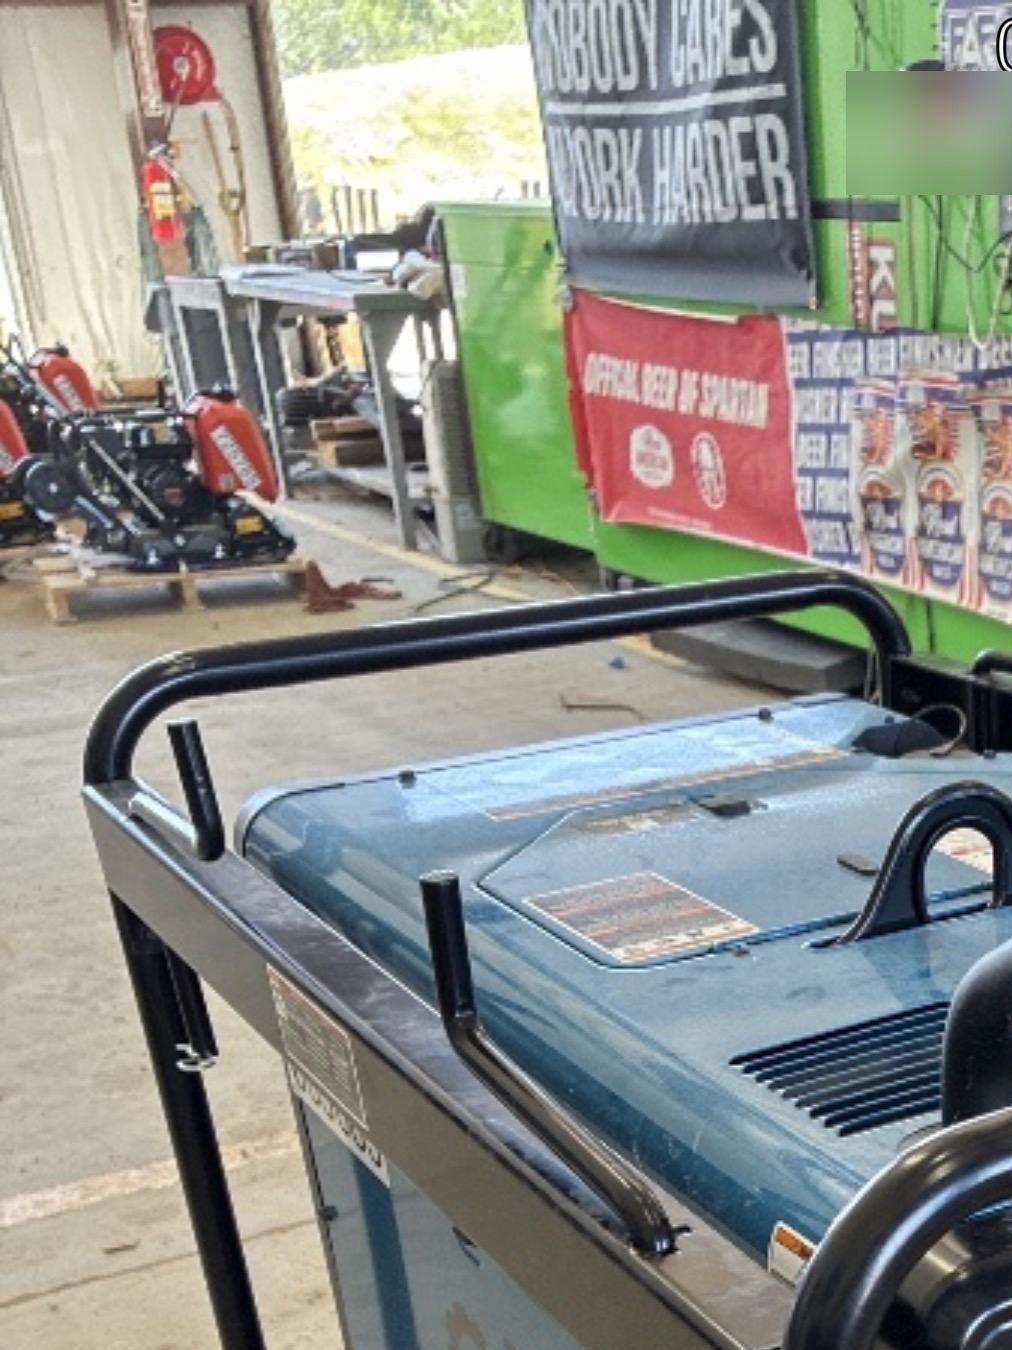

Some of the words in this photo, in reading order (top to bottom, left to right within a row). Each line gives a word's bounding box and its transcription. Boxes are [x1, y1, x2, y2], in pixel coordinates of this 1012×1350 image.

[529, 0, 657, 93] NOBODY
[669, 0, 778, 88] CARES
[547, 124, 644, 223] WORK
[653, 113, 798, 225] HARDER
[641, 362, 678, 412] BEER
[677, 367, 700, 415] OF
[699, 371, 769, 430] SPARTAN
